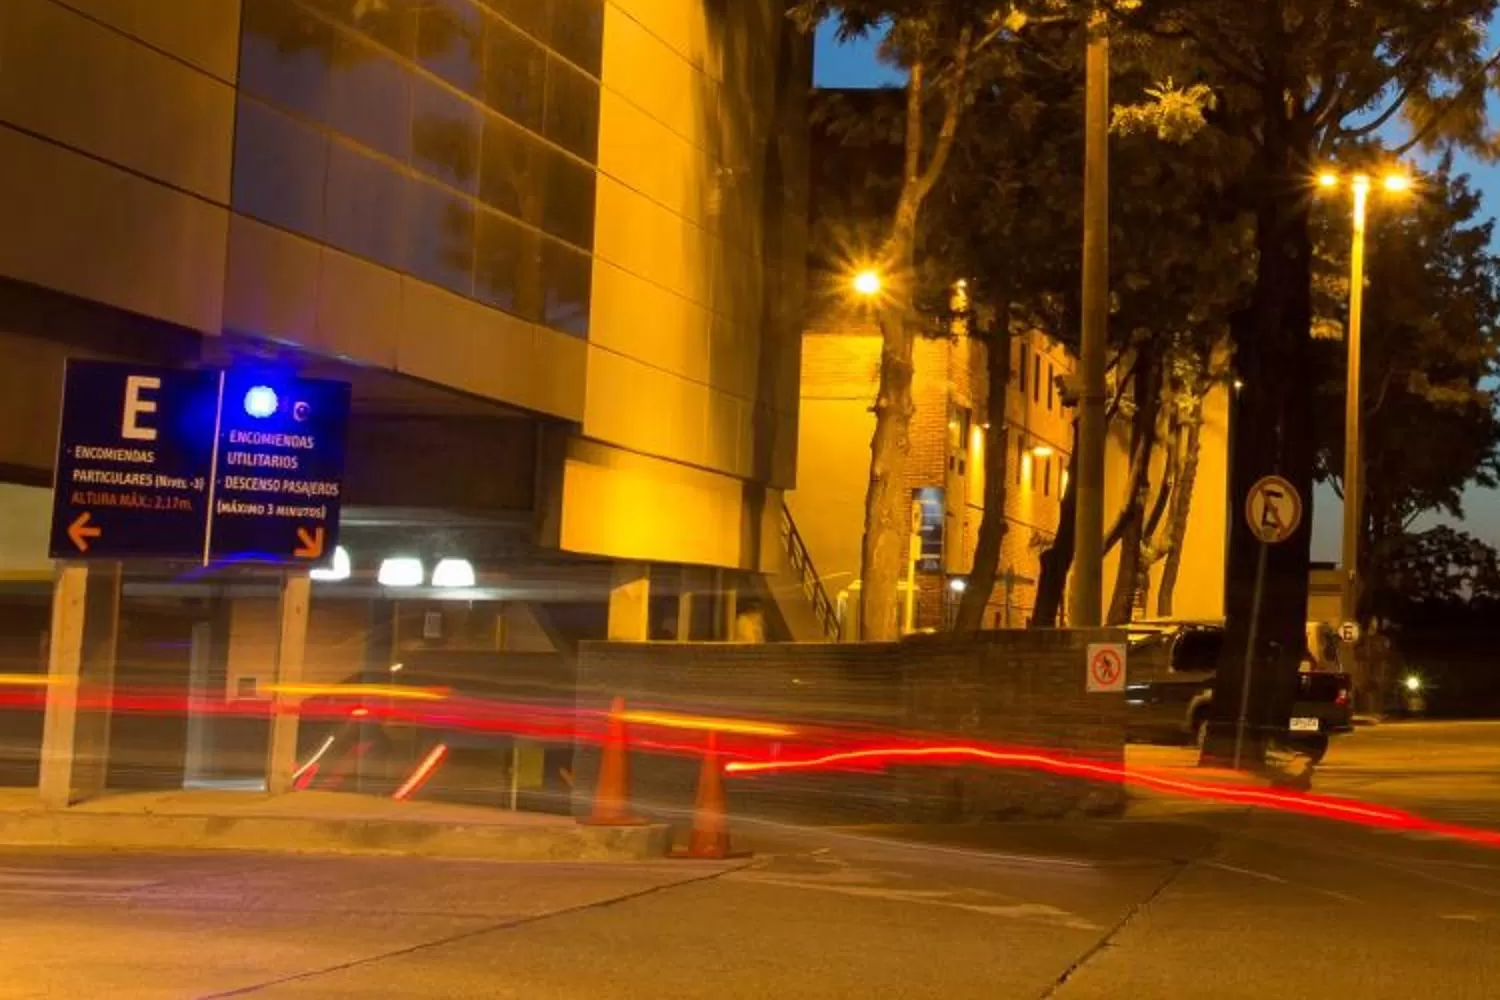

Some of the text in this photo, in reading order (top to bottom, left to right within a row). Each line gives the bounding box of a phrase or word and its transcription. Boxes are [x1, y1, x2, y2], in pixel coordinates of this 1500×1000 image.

[121, 375, 161, 440] E
[229, 429, 316, 449] ENCOMIENDAS
[75, 445, 155, 463] ENCOMIENDAS
[227, 451, 299, 469] UTILITARIOS
[72, 469, 153, 487] PARTICULARES
[224, 475, 340, 499] DESCENSO PASAJEROS
[71, 491, 117, 505] ALTURA
[267, 503, 274, 515] 3
